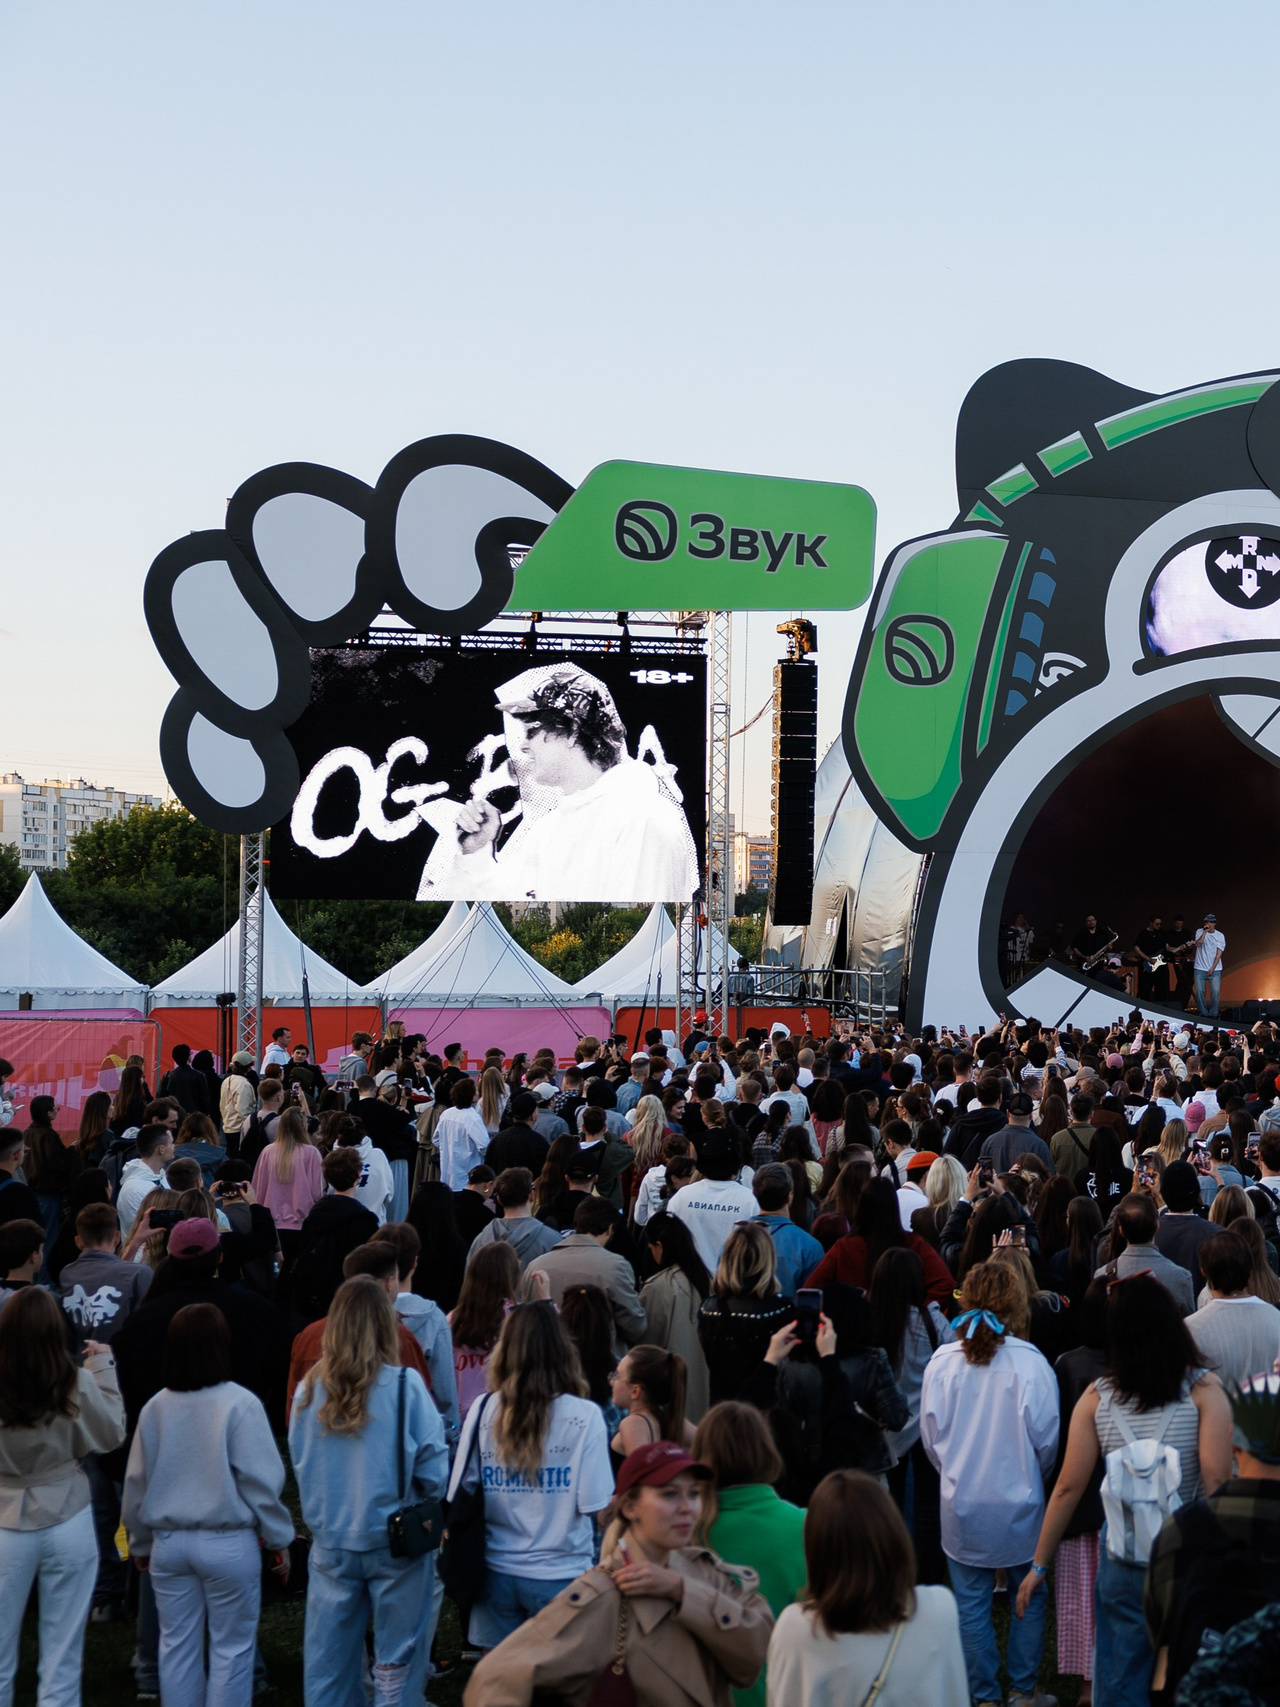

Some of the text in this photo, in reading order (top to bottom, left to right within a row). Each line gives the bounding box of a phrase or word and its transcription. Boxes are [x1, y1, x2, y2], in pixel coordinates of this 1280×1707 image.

[688, 513, 828, 573] Звук
[629, 669, 694, 685] 18+
[687, 1201, 741, 1213] АВИАПАРК
